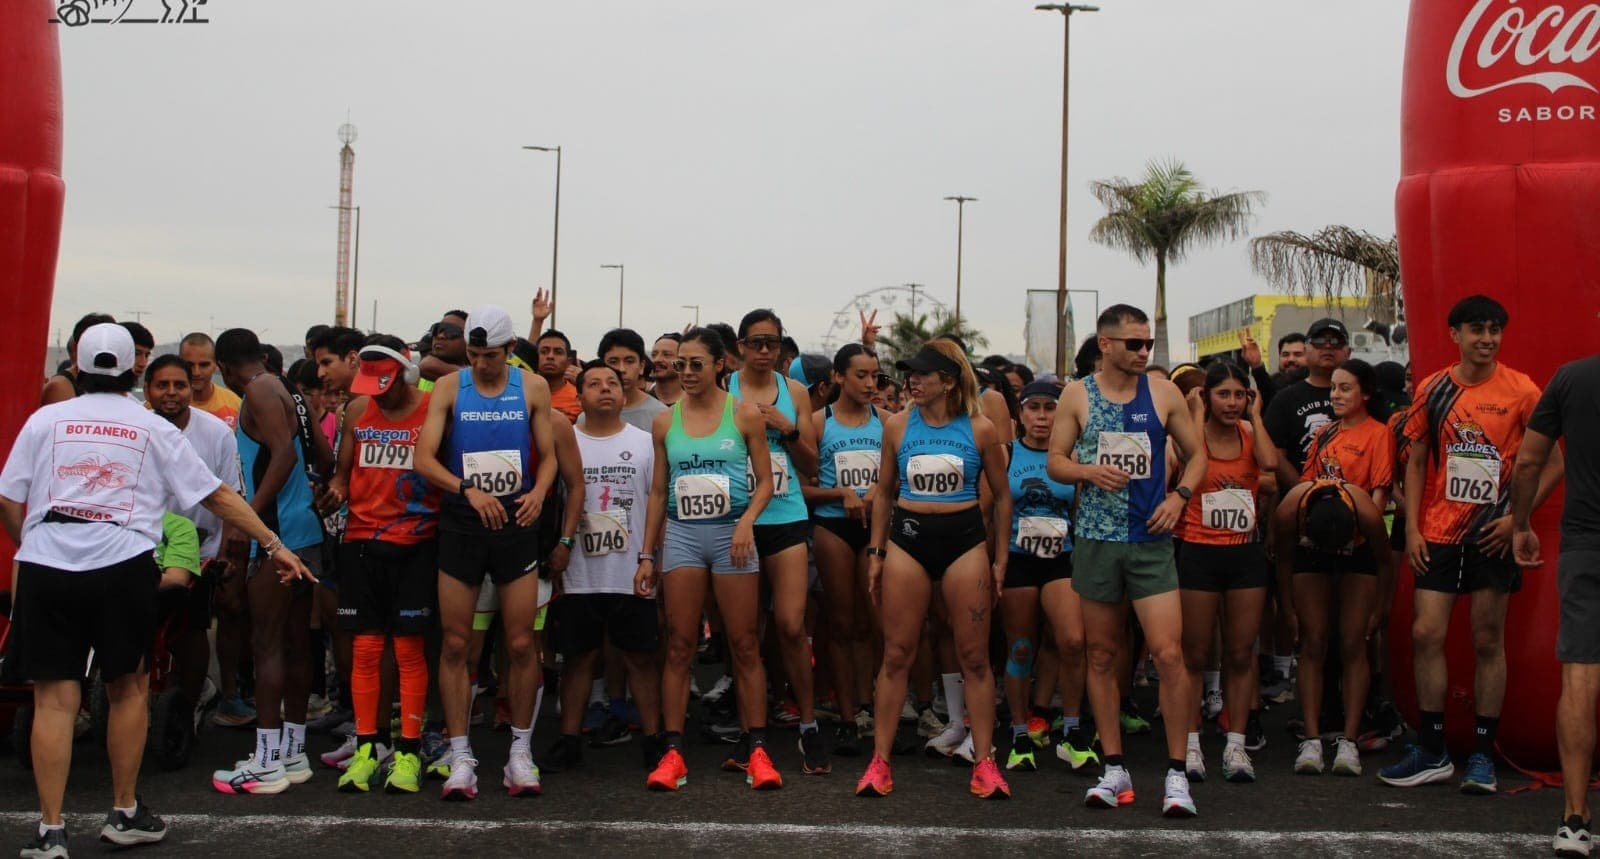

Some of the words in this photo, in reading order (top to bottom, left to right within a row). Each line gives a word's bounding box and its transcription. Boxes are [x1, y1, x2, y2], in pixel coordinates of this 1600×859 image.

[1498, 105, 1595, 122] SABOR
[460, 411, 524, 422] RENEGADE
[1296, 401, 1320, 416] CLUB
[66, 424, 137, 441] BOTANERO
[365, 443, 409, 465] 0799
[824, 439, 847, 459] CLUB
[849, 437, 882, 449] POTRO
[903, 439, 926, 453] CLUB
[583, 466, 599, 475] ran
[601, 465, 637, 475] Carrera
[840, 467, 880, 487] 0094
[470, 470, 518, 493] 0369
[913, 472, 959, 494] 0789
[1450, 475, 1493, 501] 0762
[681, 493, 726, 516] 0359
[1211, 508, 1248, 529] 0176
[583, 529, 625, 554] 0746
[1020, 536, 1063, 557] 0793
